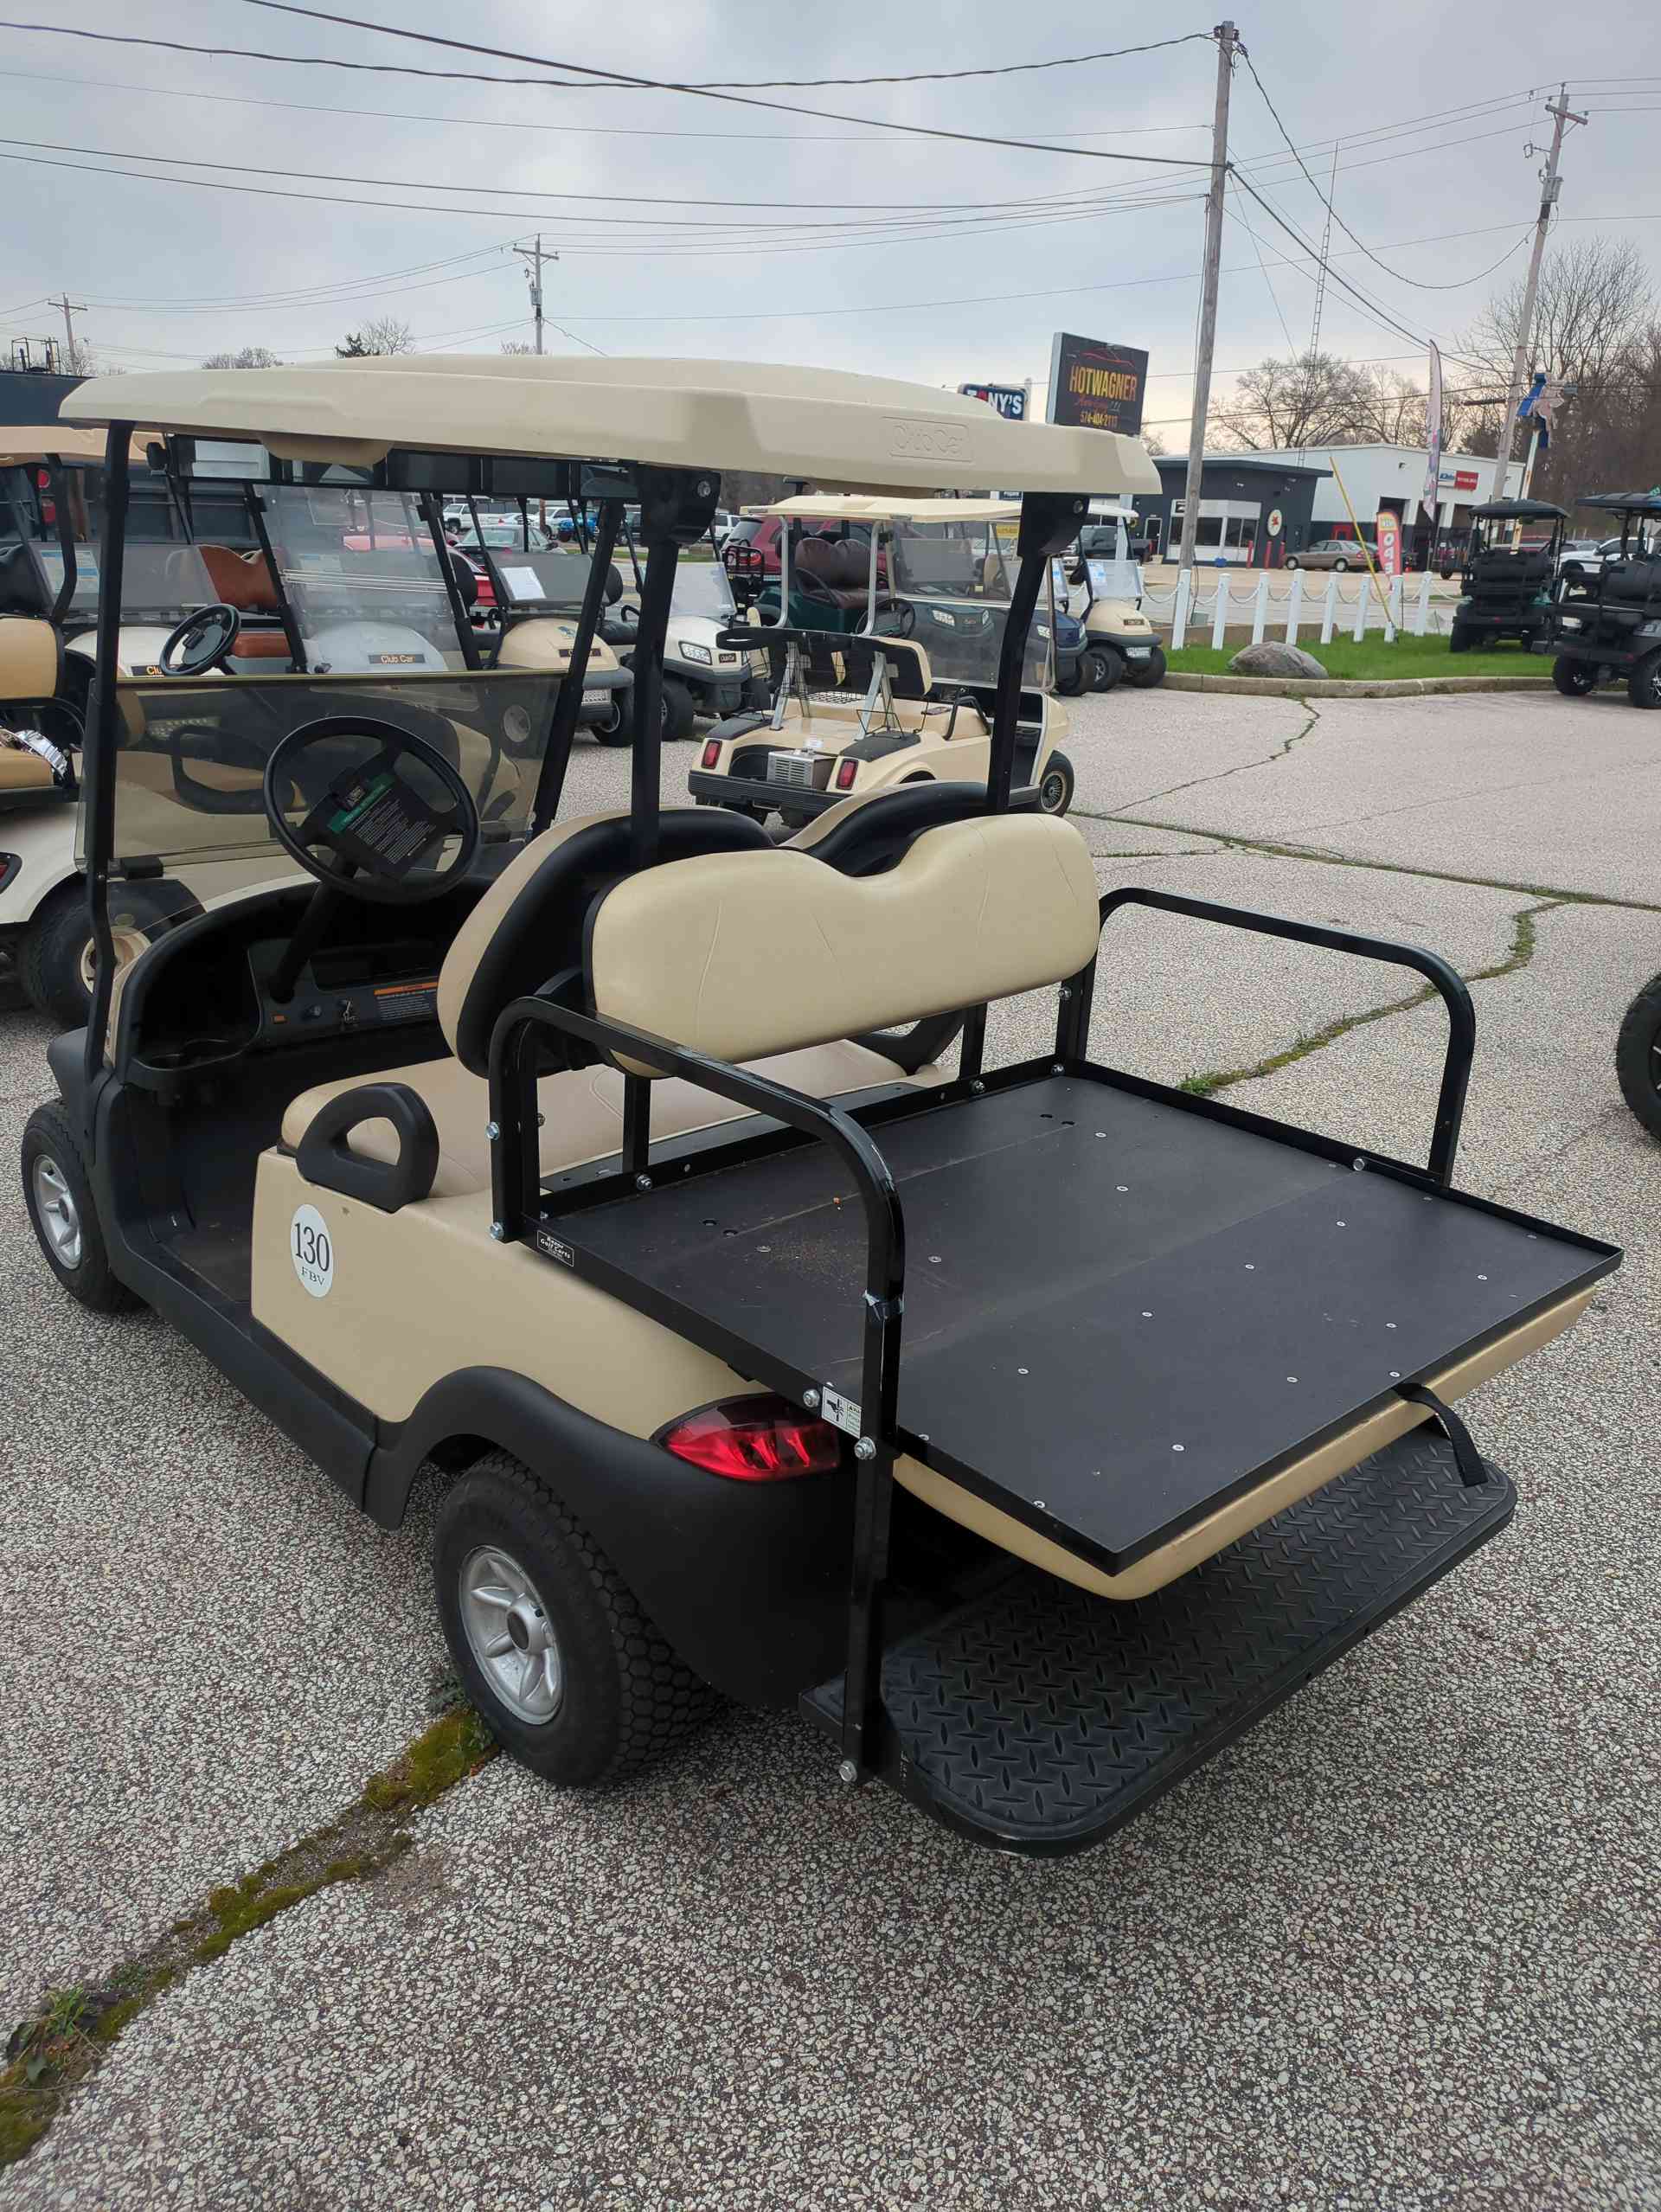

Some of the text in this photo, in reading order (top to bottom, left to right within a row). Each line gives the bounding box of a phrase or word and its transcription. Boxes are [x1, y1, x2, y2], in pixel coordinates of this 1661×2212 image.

[1068, 365, 1137, 401] HOTWAGNER
[146, 665, 164, 676] Clu
[294, 1222, 330, 1272] 130
[301, 1266, 325, 1286] FBV
